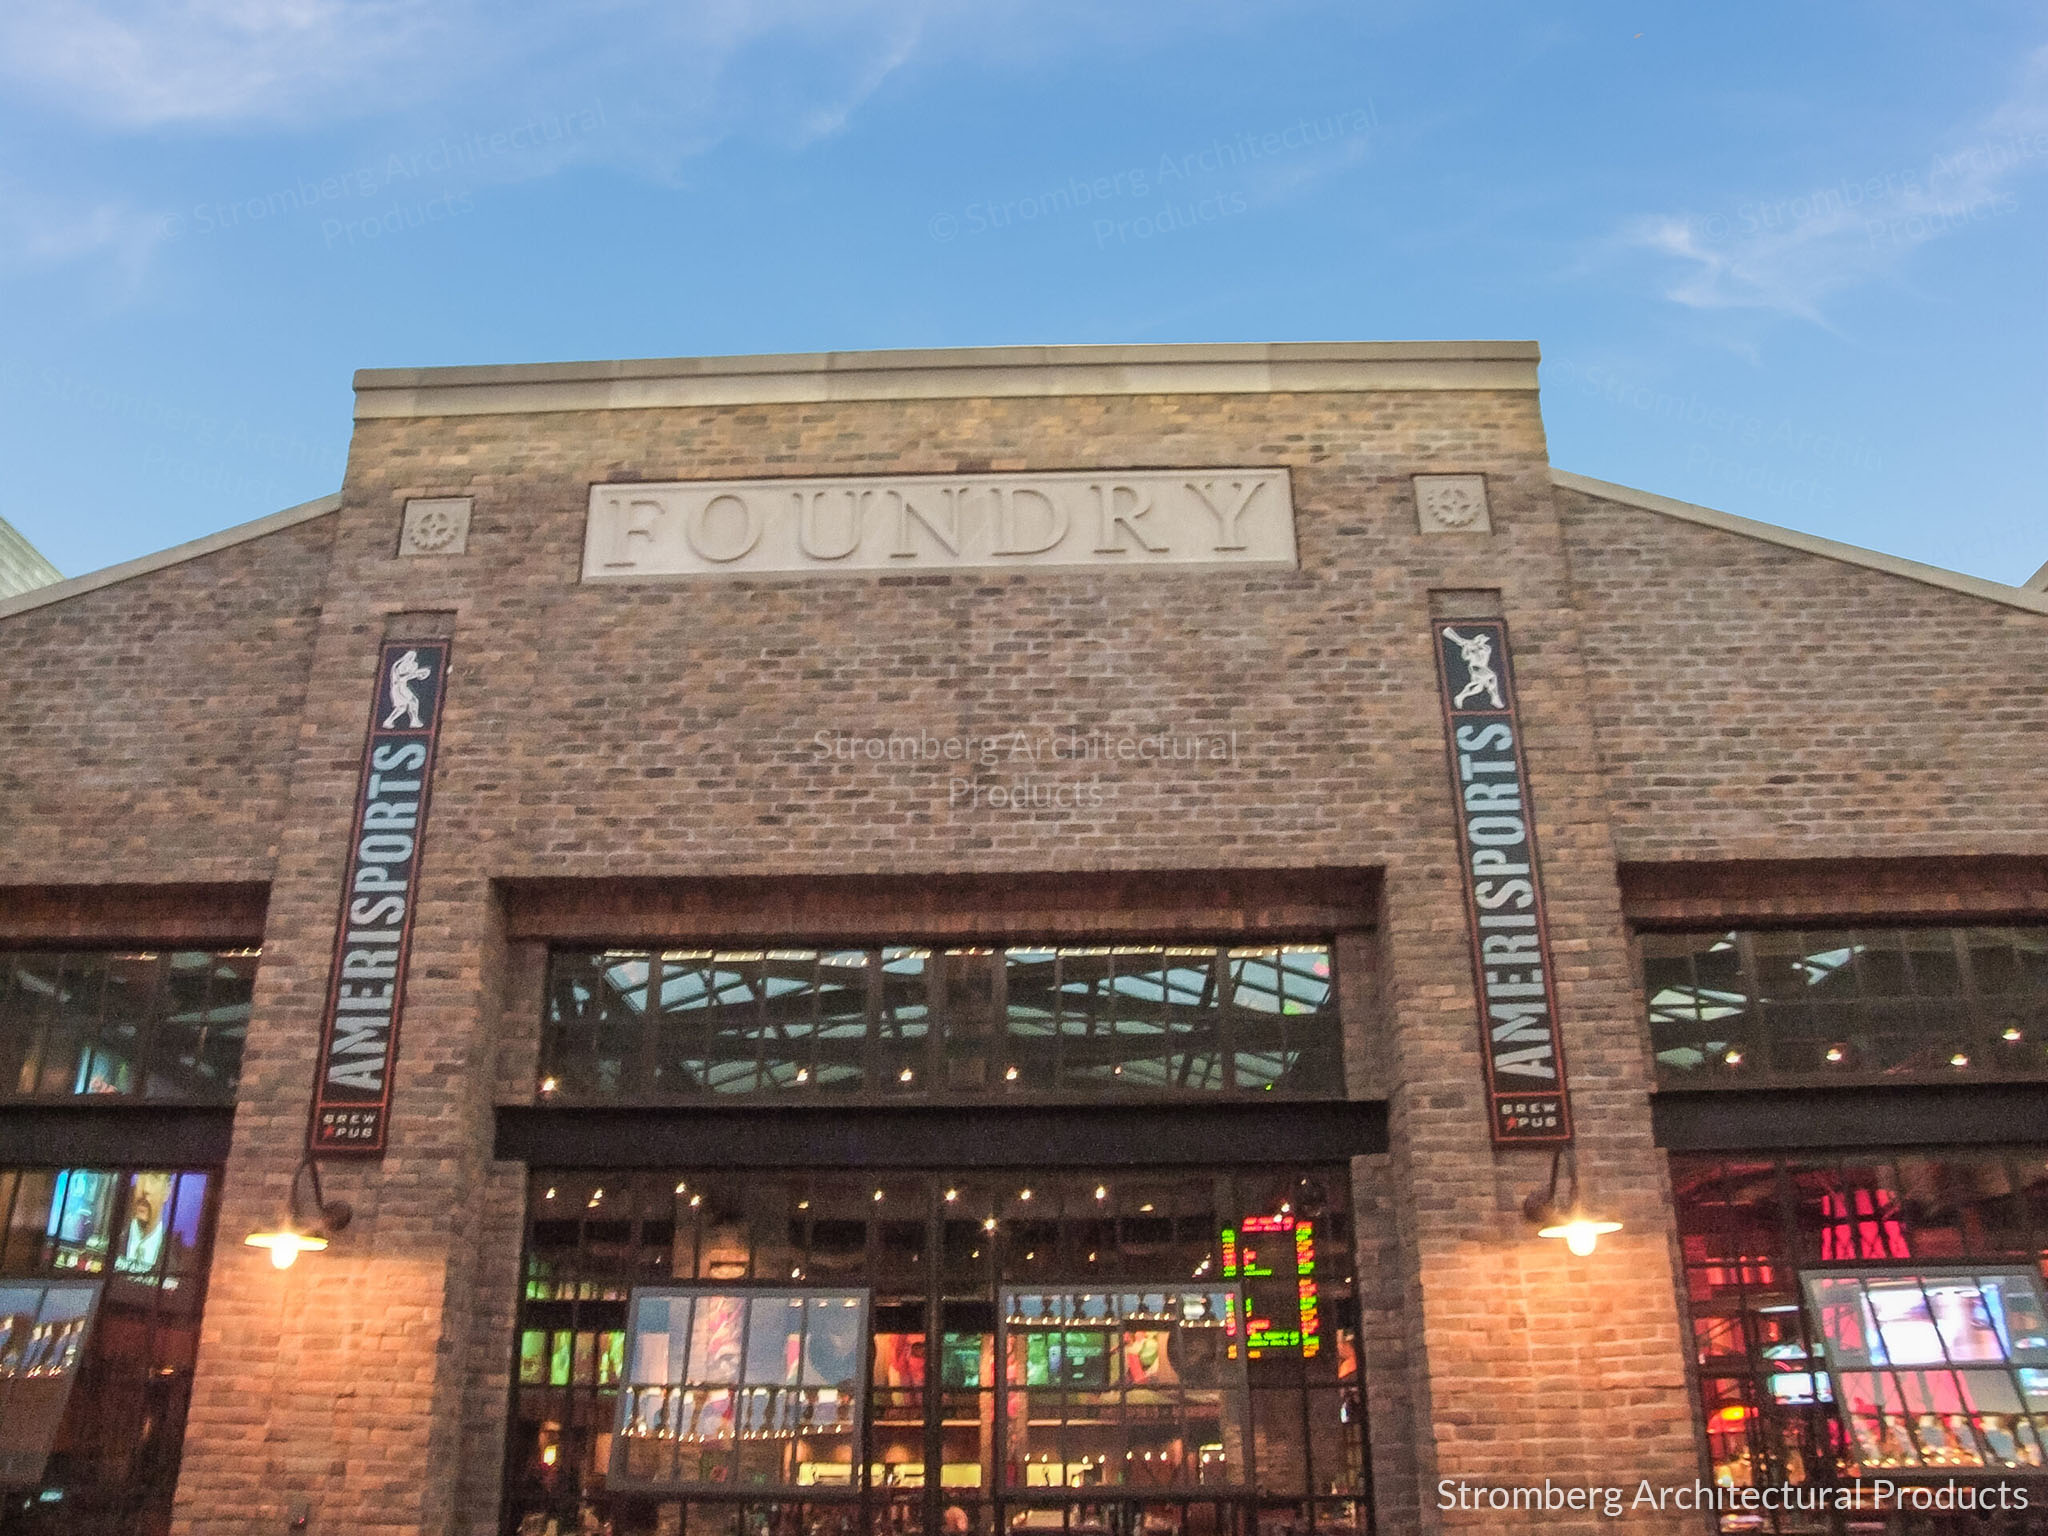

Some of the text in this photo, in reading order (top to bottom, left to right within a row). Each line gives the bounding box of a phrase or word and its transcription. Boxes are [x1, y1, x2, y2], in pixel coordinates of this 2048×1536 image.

[604, 482, 1266, 567] FOUNDRY
[328, 742, 428, 1091] AMERISPORTS
[1456, 722, 1556, 1080] AMERISPORTS
[323, 1113, 377, 1125] BREW
[335, 1127, 373, 1139] PUB
[1517, 1116, 1557, 1128] PUB
